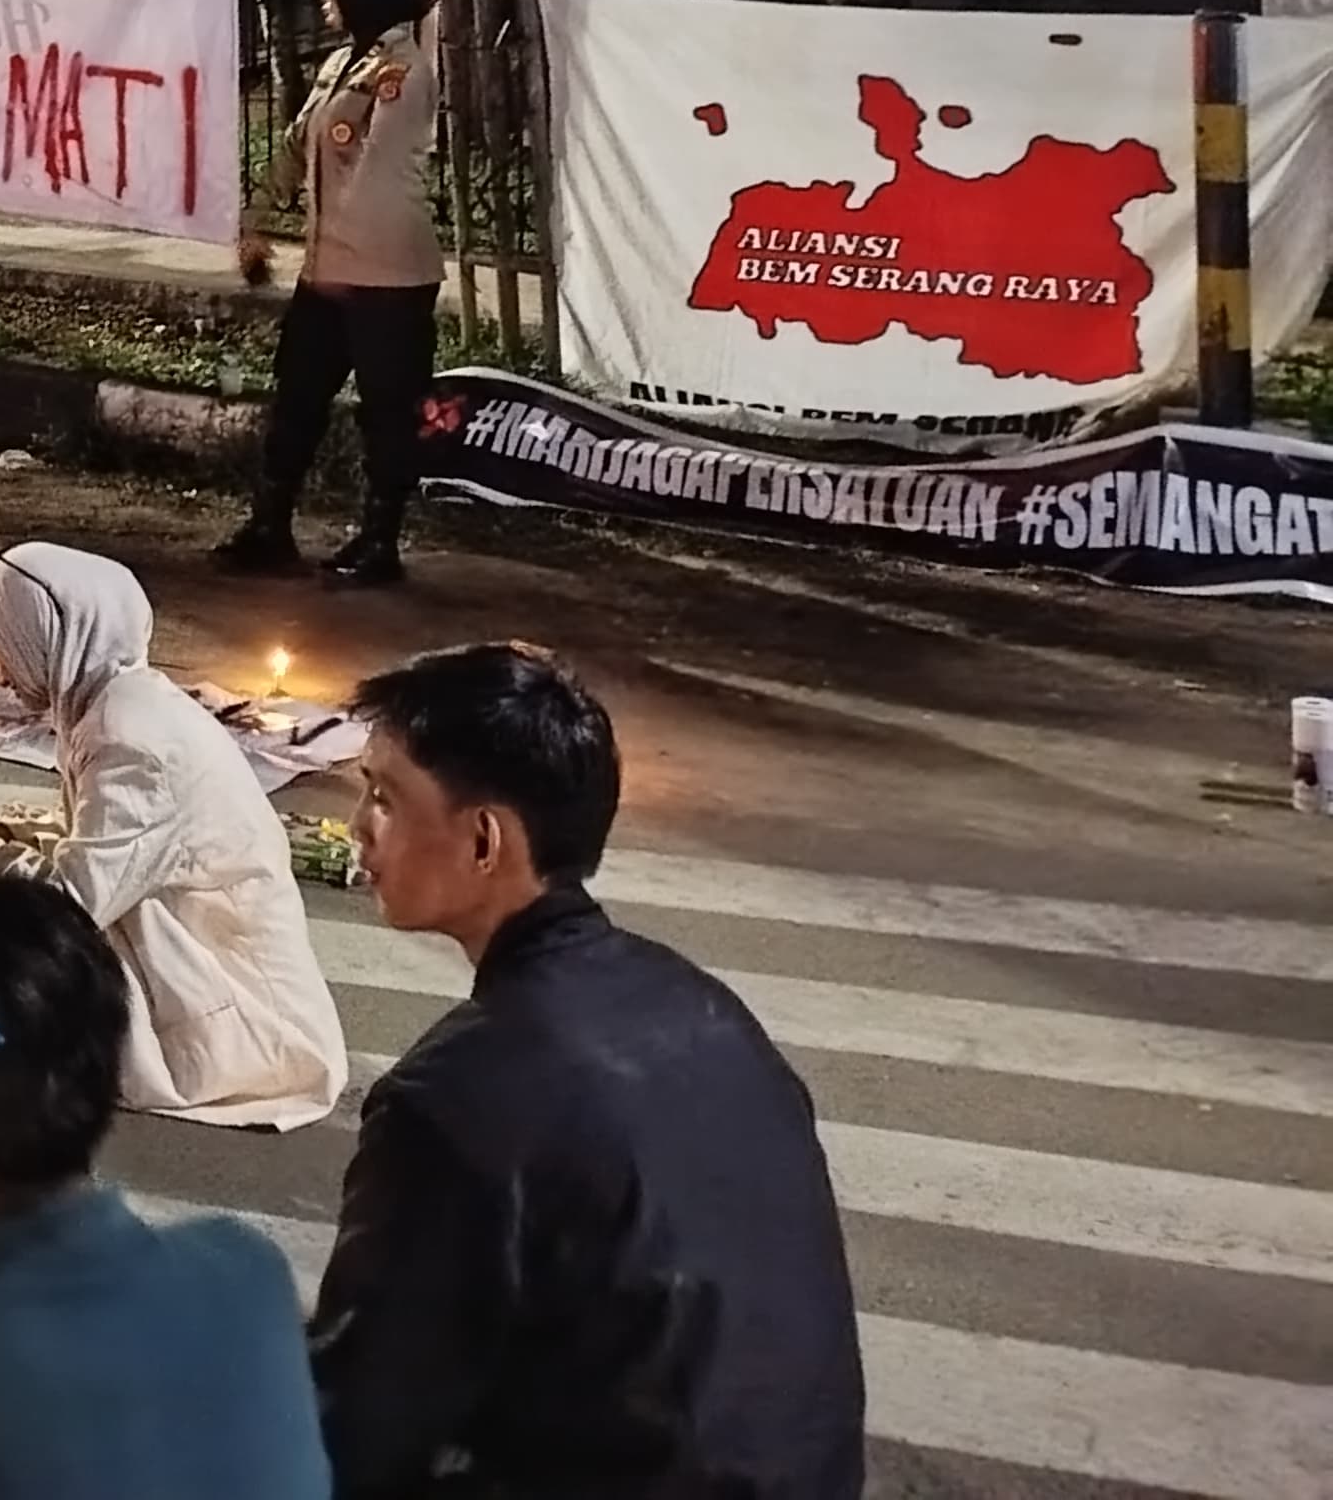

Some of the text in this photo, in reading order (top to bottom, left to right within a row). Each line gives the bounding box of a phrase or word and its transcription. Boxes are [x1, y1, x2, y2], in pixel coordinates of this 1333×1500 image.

[2, 43, 199, 216] MATI
[737, 227, 902, 260] ALIANSI
[737, 257, 1118, 305] BEM SERANG RAYA
